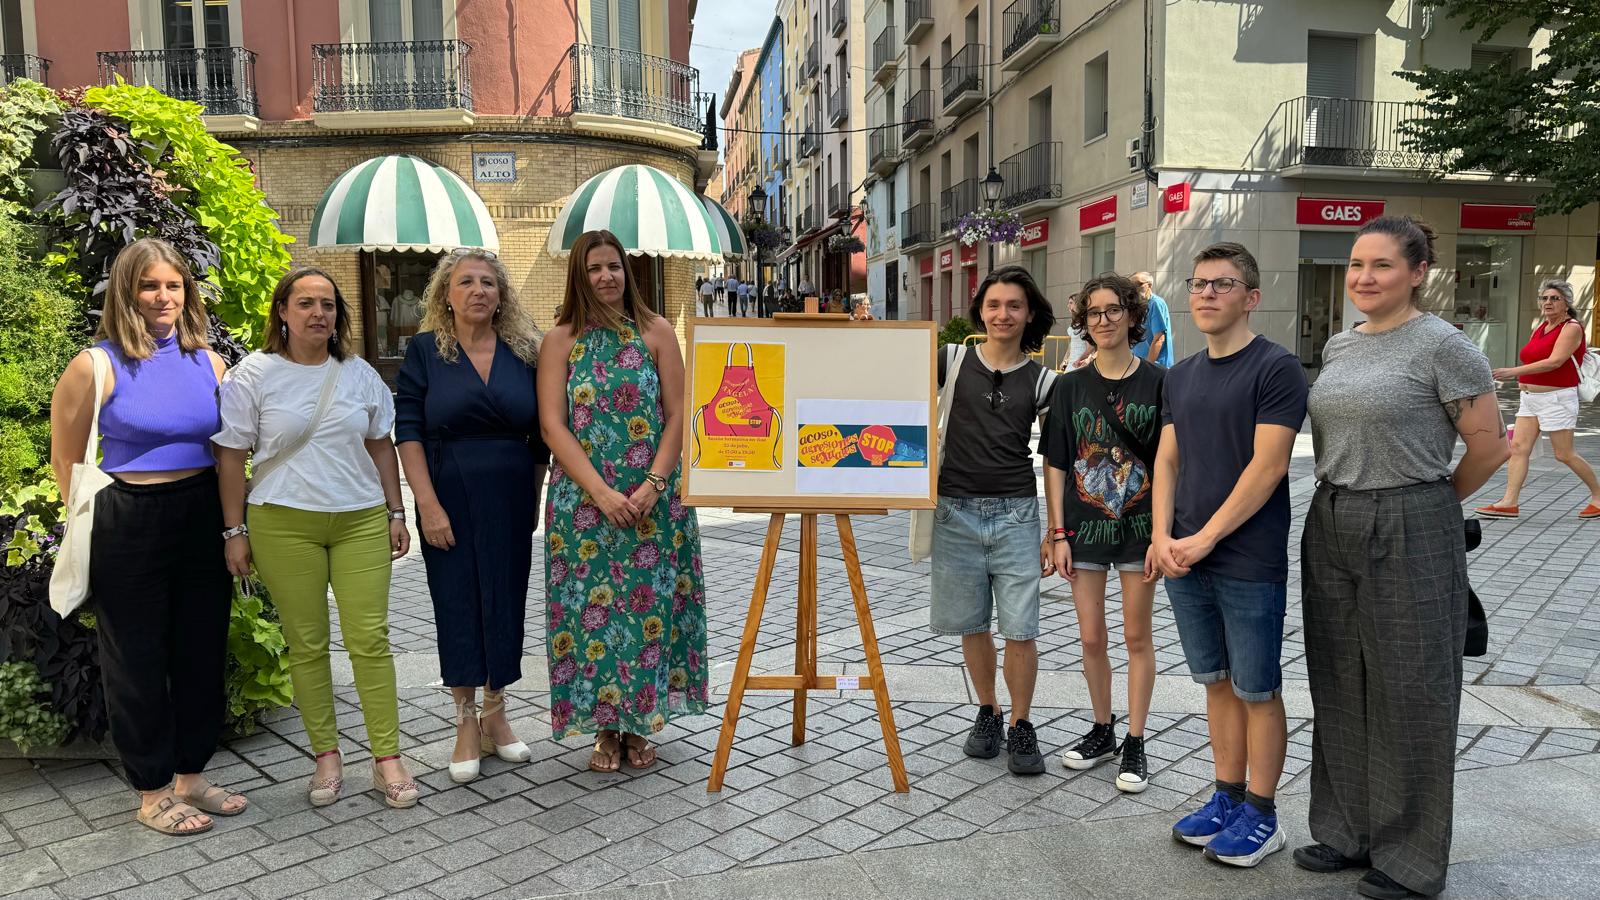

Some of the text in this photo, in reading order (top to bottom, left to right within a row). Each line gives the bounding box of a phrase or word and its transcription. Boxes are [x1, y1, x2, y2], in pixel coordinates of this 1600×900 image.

[480, 170, 511, 178] ALTO
[1168, 191, 1184, 202] GAES
[1321, 204, 1362, 221] GAES
[799, 429, 838, 446] acoso,
[800, 433, 859, 456] agresiones
[861, 432, 895, 455] STOP
[810, 443, 858, 465] sexuales
[1074, 518, 1127, 545] PLANET
